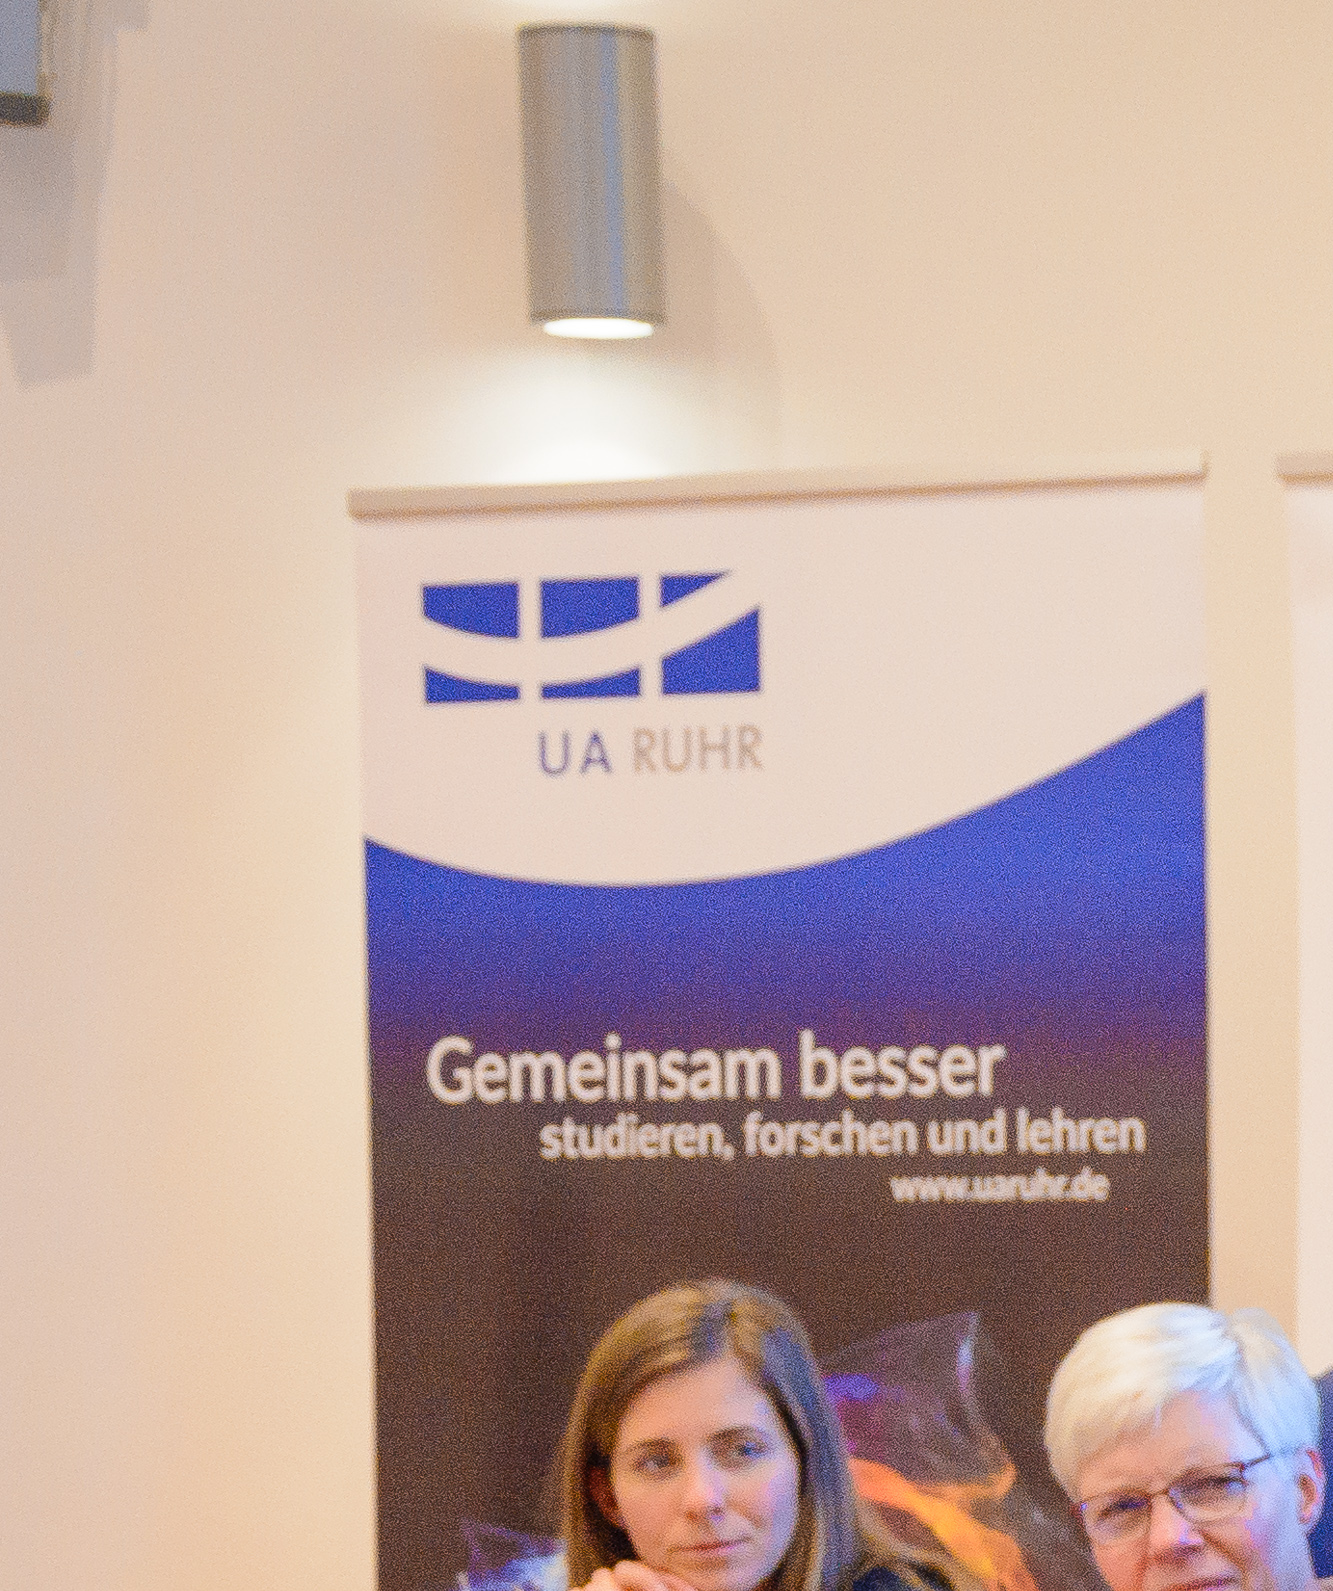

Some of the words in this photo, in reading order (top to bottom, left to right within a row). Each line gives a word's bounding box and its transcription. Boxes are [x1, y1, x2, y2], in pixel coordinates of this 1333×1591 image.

[540, 731, 612, 777] UA
[633, 723, 764, 774] RUHR
[426, 1033, 783, 1104] Gemeinsam
[800, 1031, 1006, 1099] besser
[540, 1113, 735, 1163] studieren,
[744, 1110, 919, 1158] forschen
[928, 1109, 1006, 1156] und
[1016, 1108, 1147, 1155] lehren
[891, 1167, 1110, 1204] www.uaruhr.de
